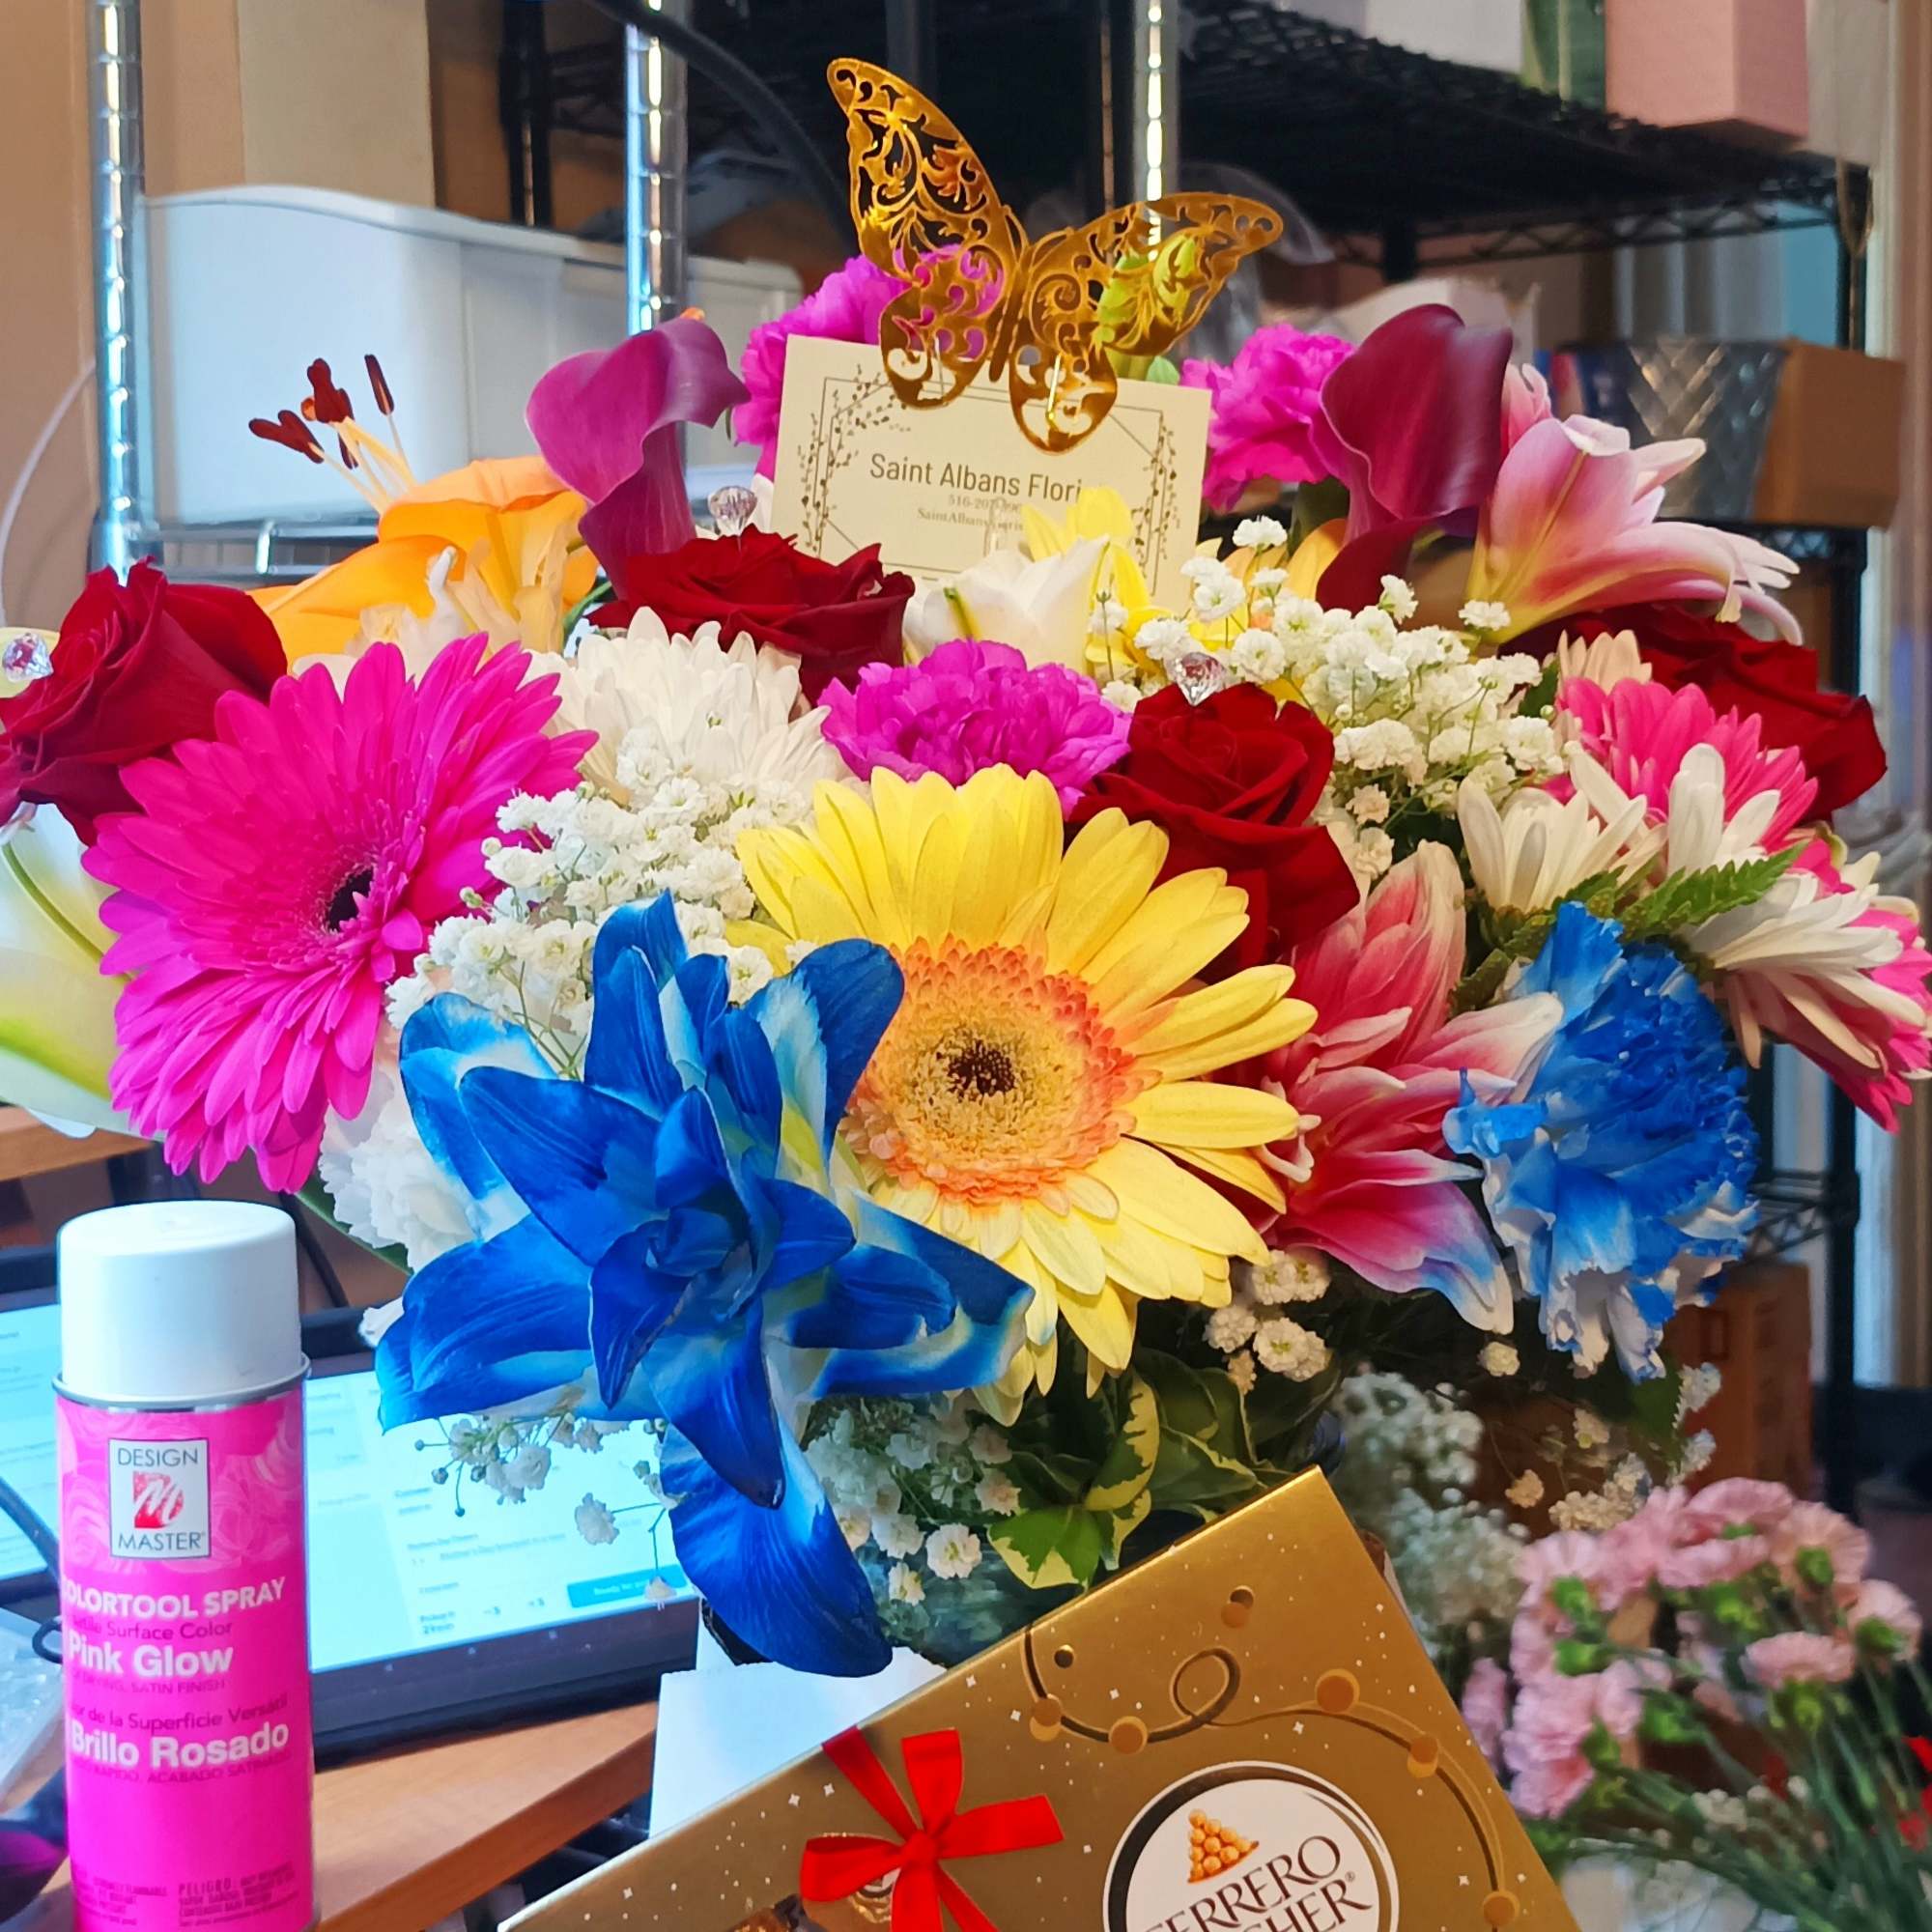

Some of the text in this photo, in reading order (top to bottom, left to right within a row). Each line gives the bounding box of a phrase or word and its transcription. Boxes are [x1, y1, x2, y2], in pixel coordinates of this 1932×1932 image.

[869, 453, 1083, 503] Saint Albans Flori
[117, 1447, 199, 1467] DESIGN
[117, 1532, 203, 1551] MASTER
[63, 1576, 287, 1620] OLORTOOL SPRAY
[106, 1621, 175, 1640] Surface
[179, 1620, 233, 1639] Color
[68, 1628, 234, 1678] Pink Glow
[71, 1718, 290, 1769] Brillo Rosado
[109, 1710, 124, 1727] la
[128, 1711, 224, 1736] Superficie
[1242, 1878, 1373, 1932] HER
